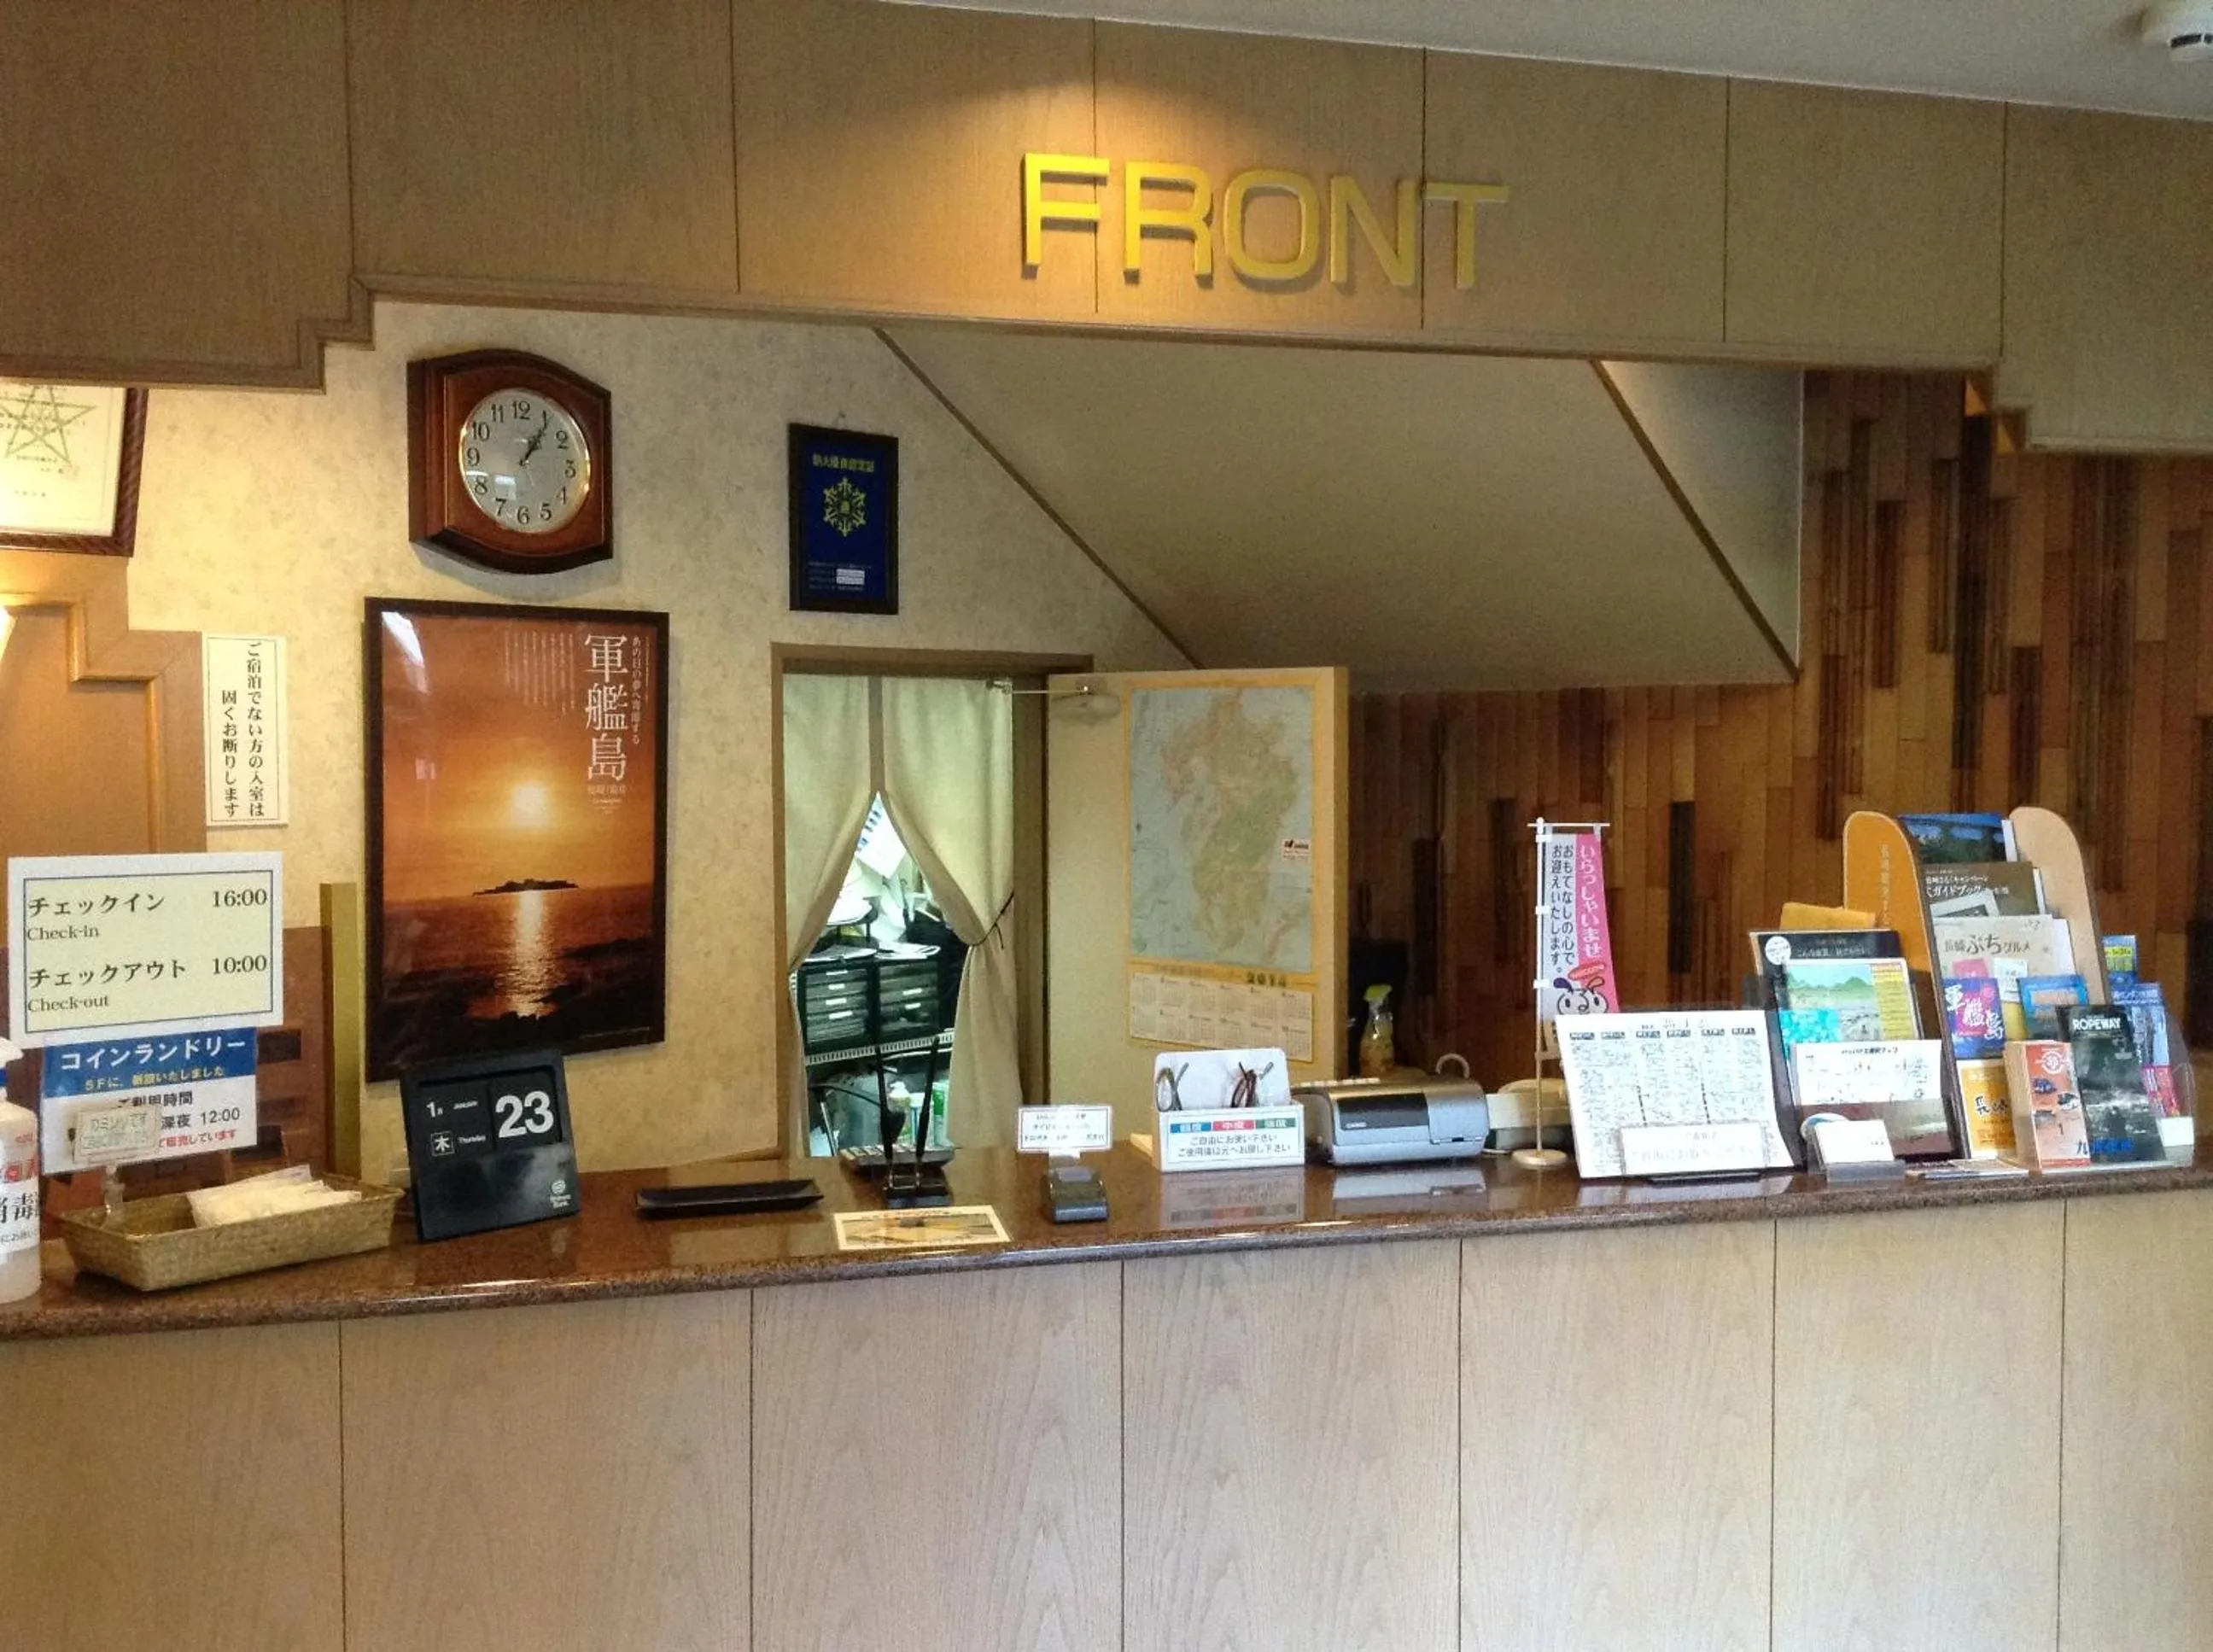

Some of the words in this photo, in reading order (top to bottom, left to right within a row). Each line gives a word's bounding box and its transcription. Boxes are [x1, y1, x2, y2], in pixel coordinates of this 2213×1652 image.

[1024, 153, 1509, 290] FRONT
[491, 404, 505, 423] 11
[512, 400, 531, 420] 12
[472, 422, 490, 441] 10
[556, 430, 568, 449] 2
[467, 447, 480, 466] 9
[564, 460, 576, 478] 3
[475, 476, 488, 494] 8
[556, 487, 568, 505] 4
[495, 498, 507, 517] 7
[517, 505, 530, 524] 6
[540, 504, 552, 521] 5
[584, 633, 629, 781] 軍艦島
[247, 642, 265, 817] ご宿泊でない方の入室は
[222, 690, 239, 817] 固くお断りします
[28, 892, 166, 918] チェックイン
[213, 888, 268, 908] 16:00
[1562, 845, 1575, 966] おもてなしの心で
[1580, 845, 1601, 957] いらっしゃいませ
[26, 925, 100, 940] Check-in
[28, 959, 186, 989] チェックアウト
[213, 954, 267, 975] 10:00
[27, 995, 110, 1013] Check-out
[2073, 1018, 2121, 1030] ROPEWAY
[61, 1036, 246, 1071] コインランドリー
[200, 1107, 241, 1125] 12:00
[495, 1090, 554, 1138] 23
[435, 1135, 450, 1153] 木
